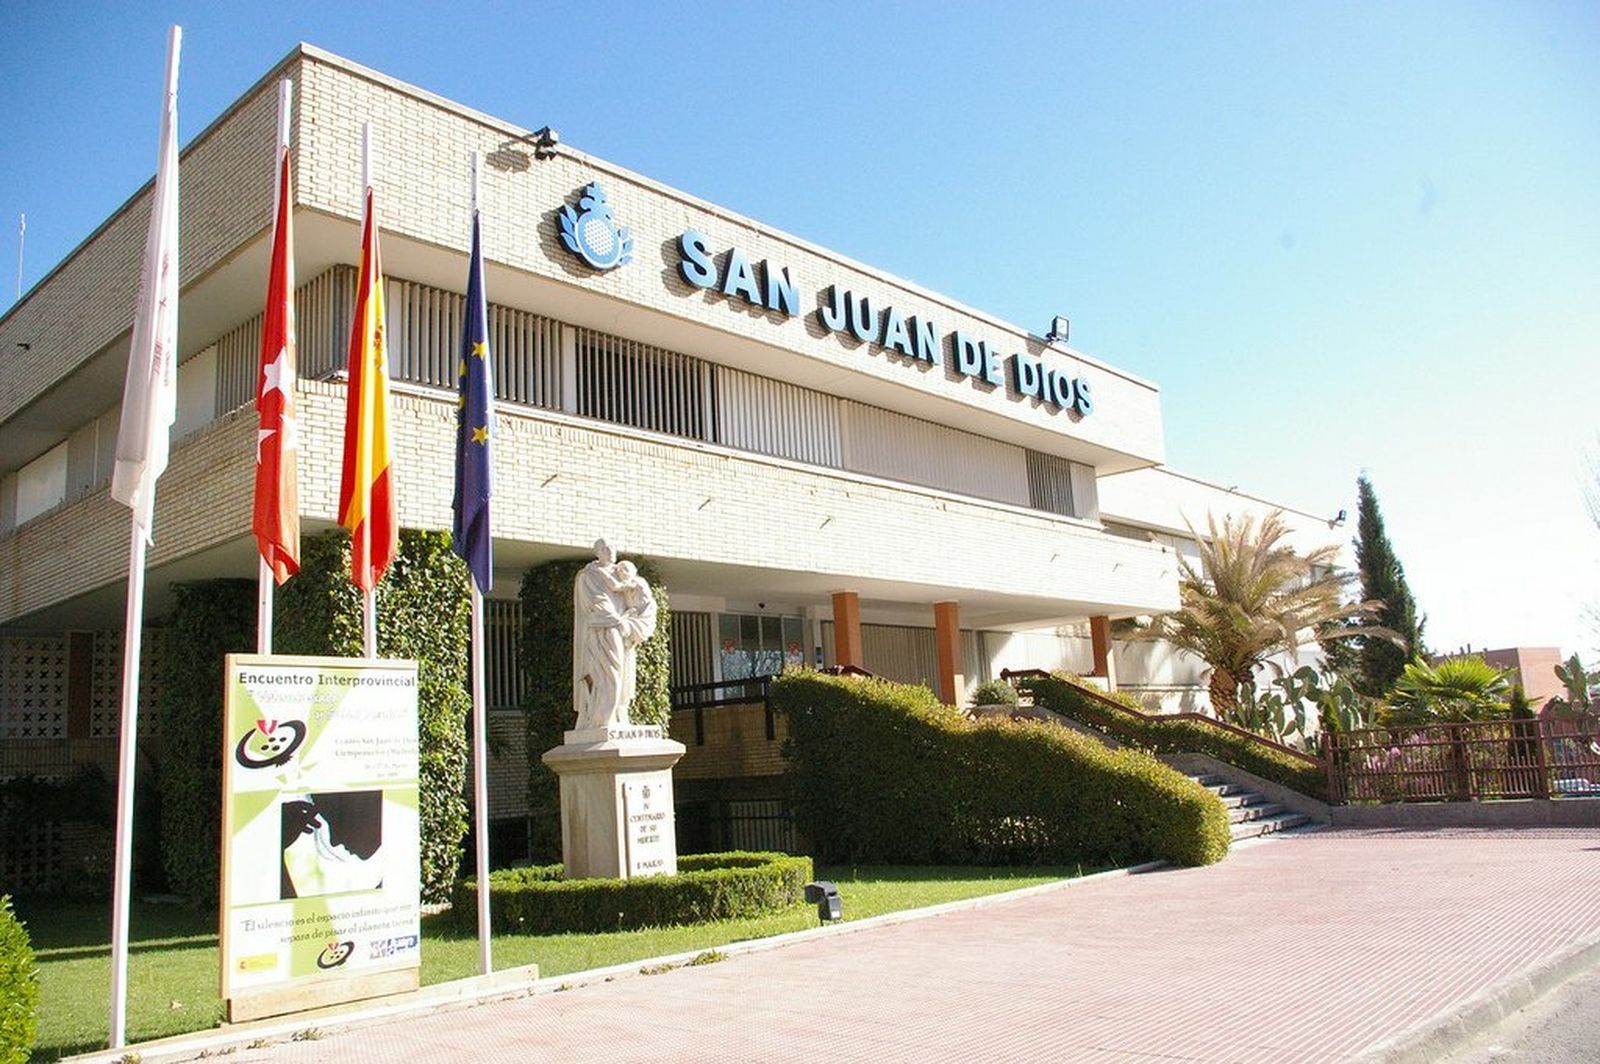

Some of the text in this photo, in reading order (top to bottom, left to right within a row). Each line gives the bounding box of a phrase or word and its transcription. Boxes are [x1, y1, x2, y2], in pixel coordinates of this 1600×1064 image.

[677, 227, 1094, 417] SAN JUAN DE DIOS
[239, 672, 415, 688] Encuentro Interprovincial
[257, 917, 294, 930] silencio
[295, 917, 305, 926] es
[306, 912, 315, 924] el
[316, 911, 350, 925] espacio
[311, 928, 324, 939] de
